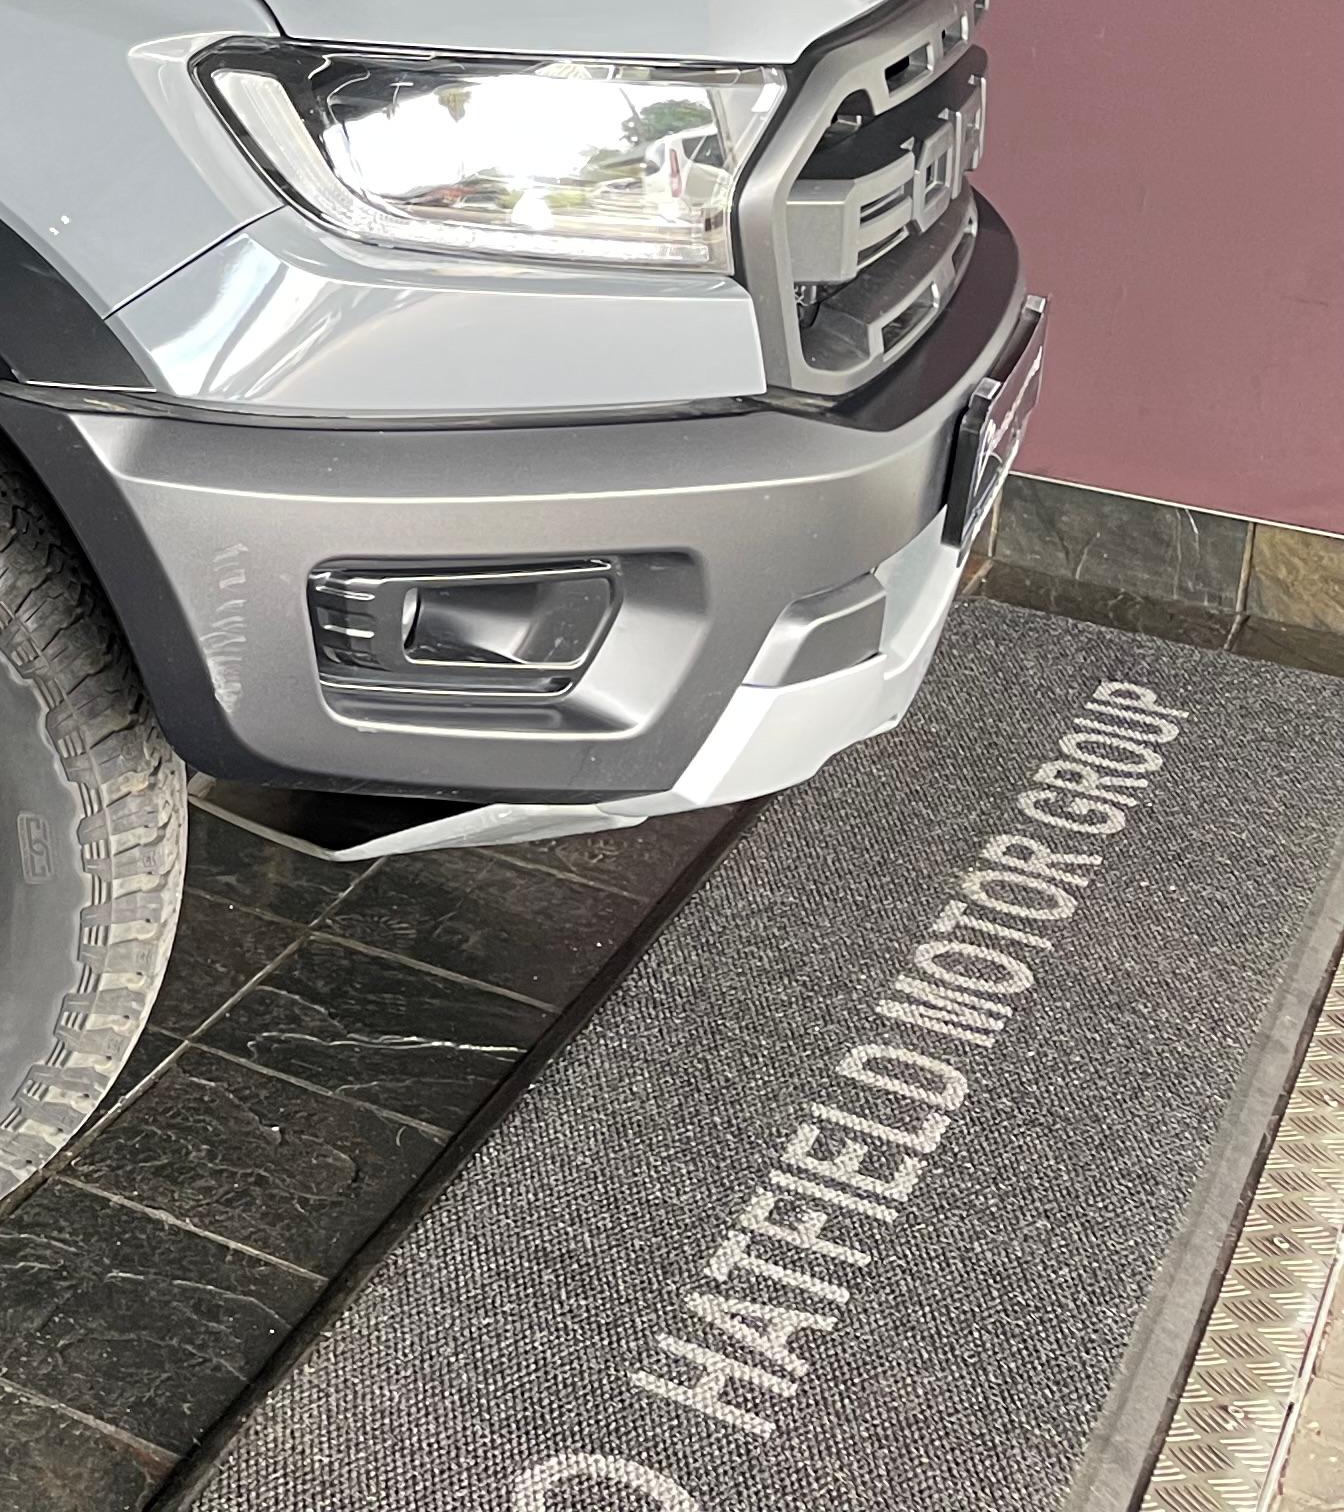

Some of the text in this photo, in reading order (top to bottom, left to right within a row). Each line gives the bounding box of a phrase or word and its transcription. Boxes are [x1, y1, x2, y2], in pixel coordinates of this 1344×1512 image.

[630, 679, 1192, 1440] HATFIELD MOTOR GROUP
